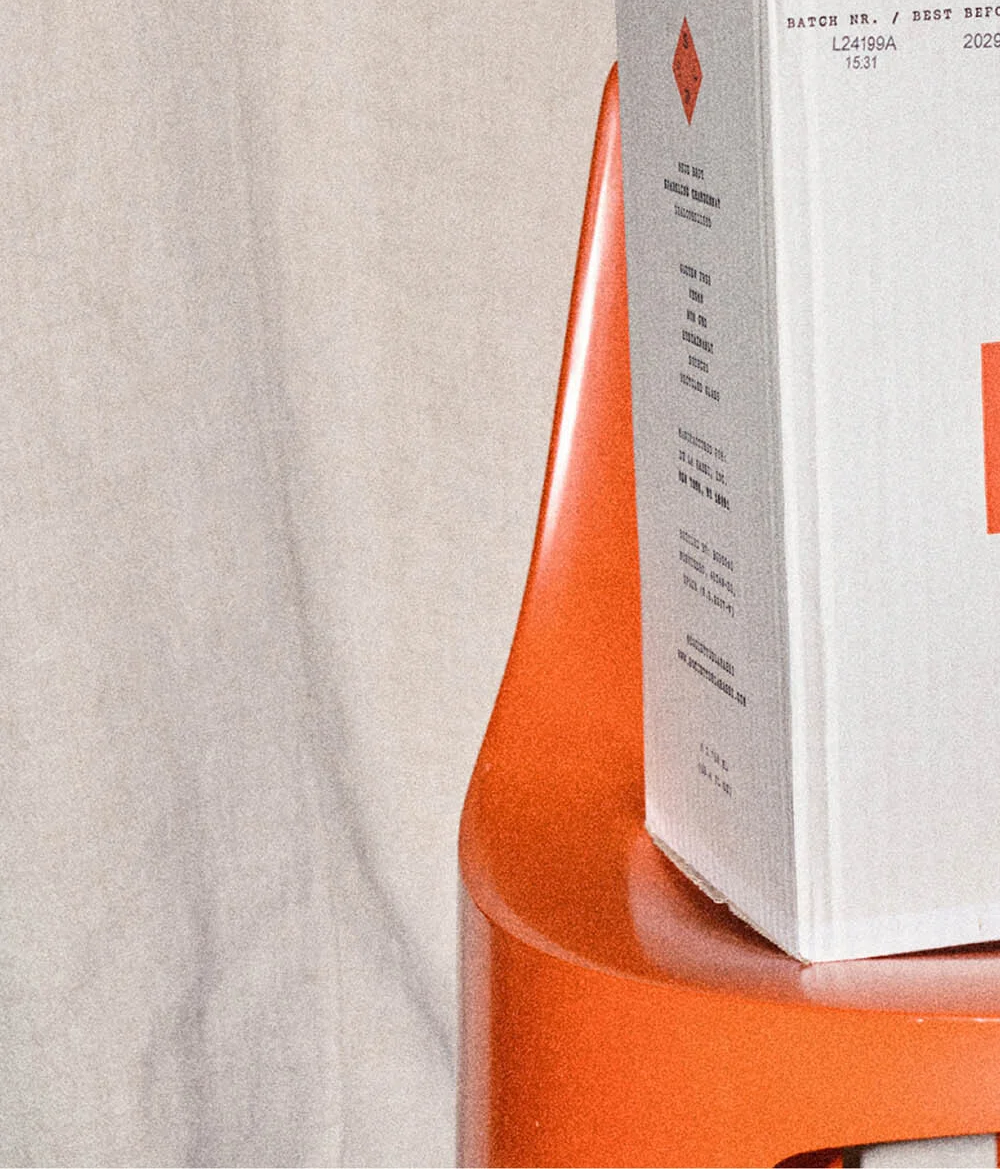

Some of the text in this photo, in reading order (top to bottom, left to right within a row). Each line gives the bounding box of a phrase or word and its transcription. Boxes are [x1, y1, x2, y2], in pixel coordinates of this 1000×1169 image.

[787, 15, 838, 29] BATCH
[849, 13, 878, 26] NR.
[891, 11, 900, 25] /
[912, 8, 952, 22] BEST
[832, 35, 897, 52] L24199A
